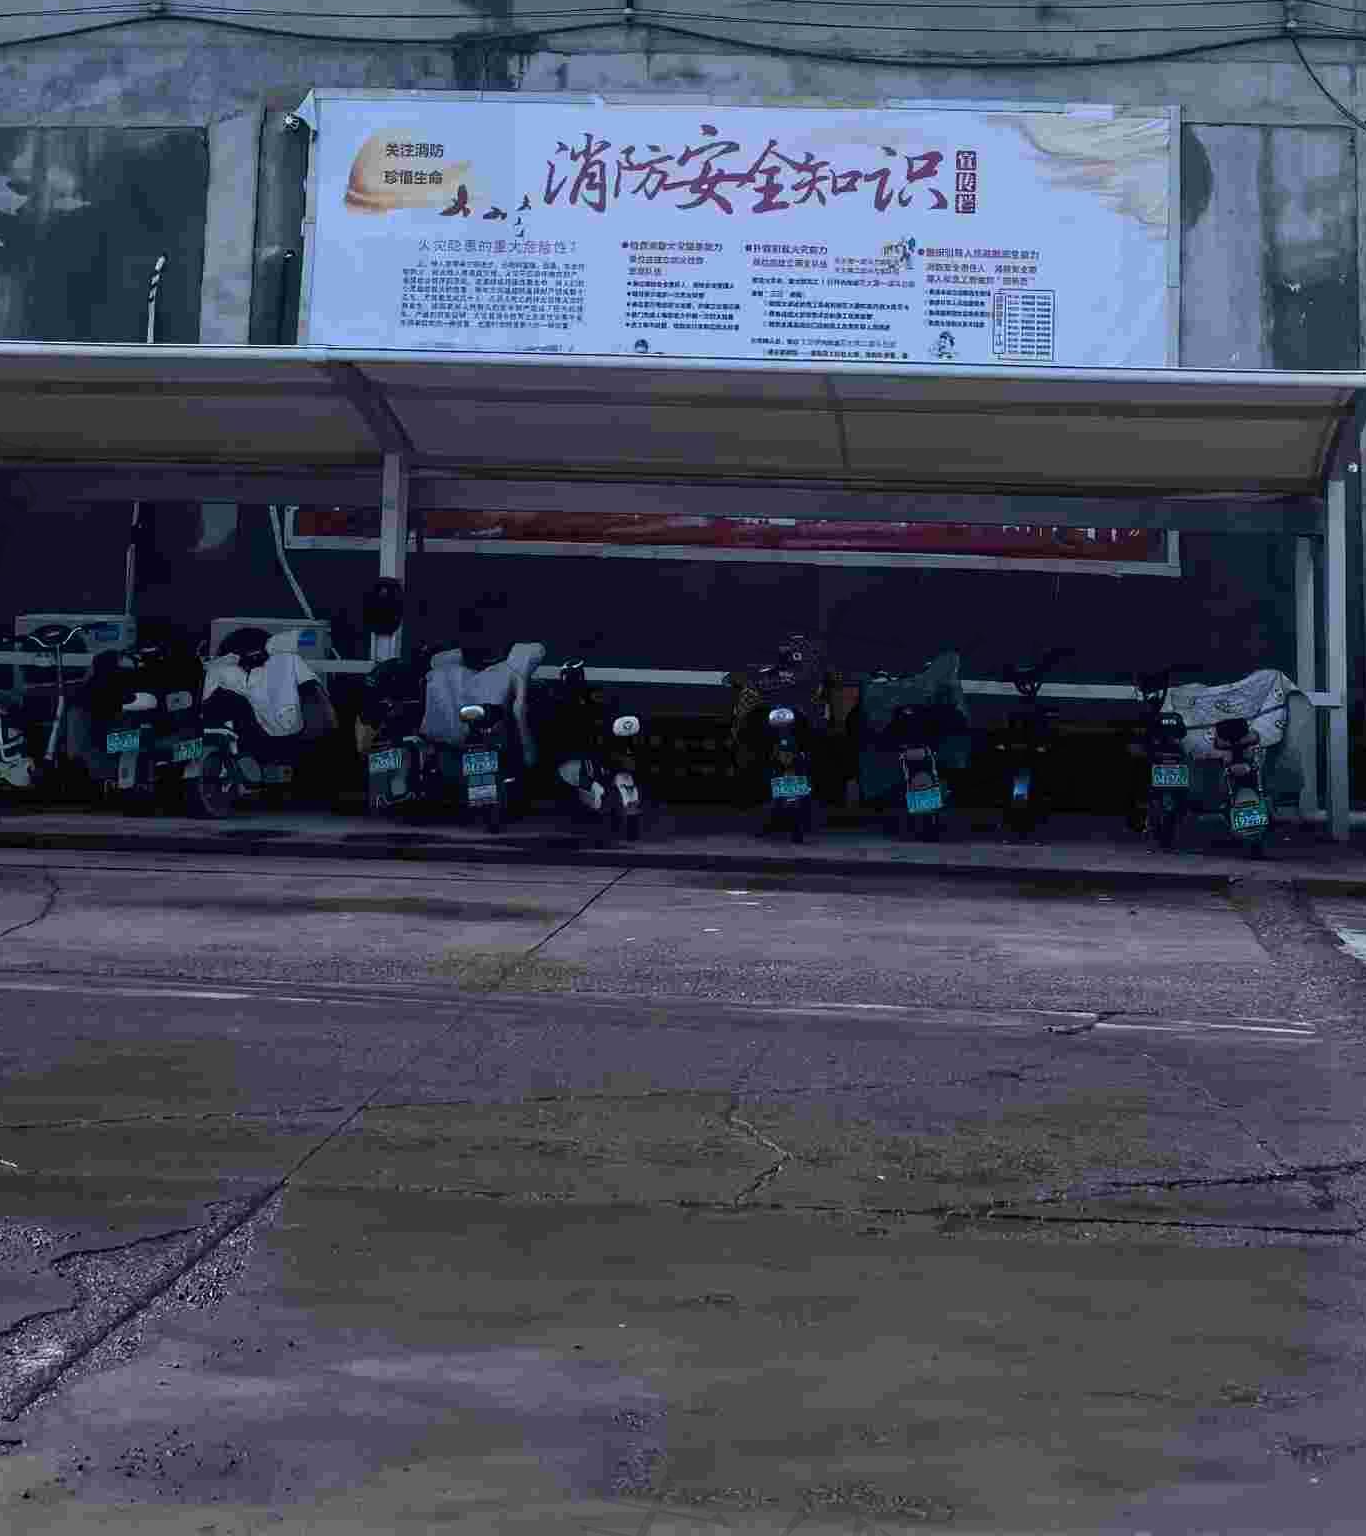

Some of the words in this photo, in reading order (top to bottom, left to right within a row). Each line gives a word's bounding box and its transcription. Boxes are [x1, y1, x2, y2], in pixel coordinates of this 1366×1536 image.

[385, 143, 444, 159] 关注消防
[545, 124, 948, 214] 消防安全知识
